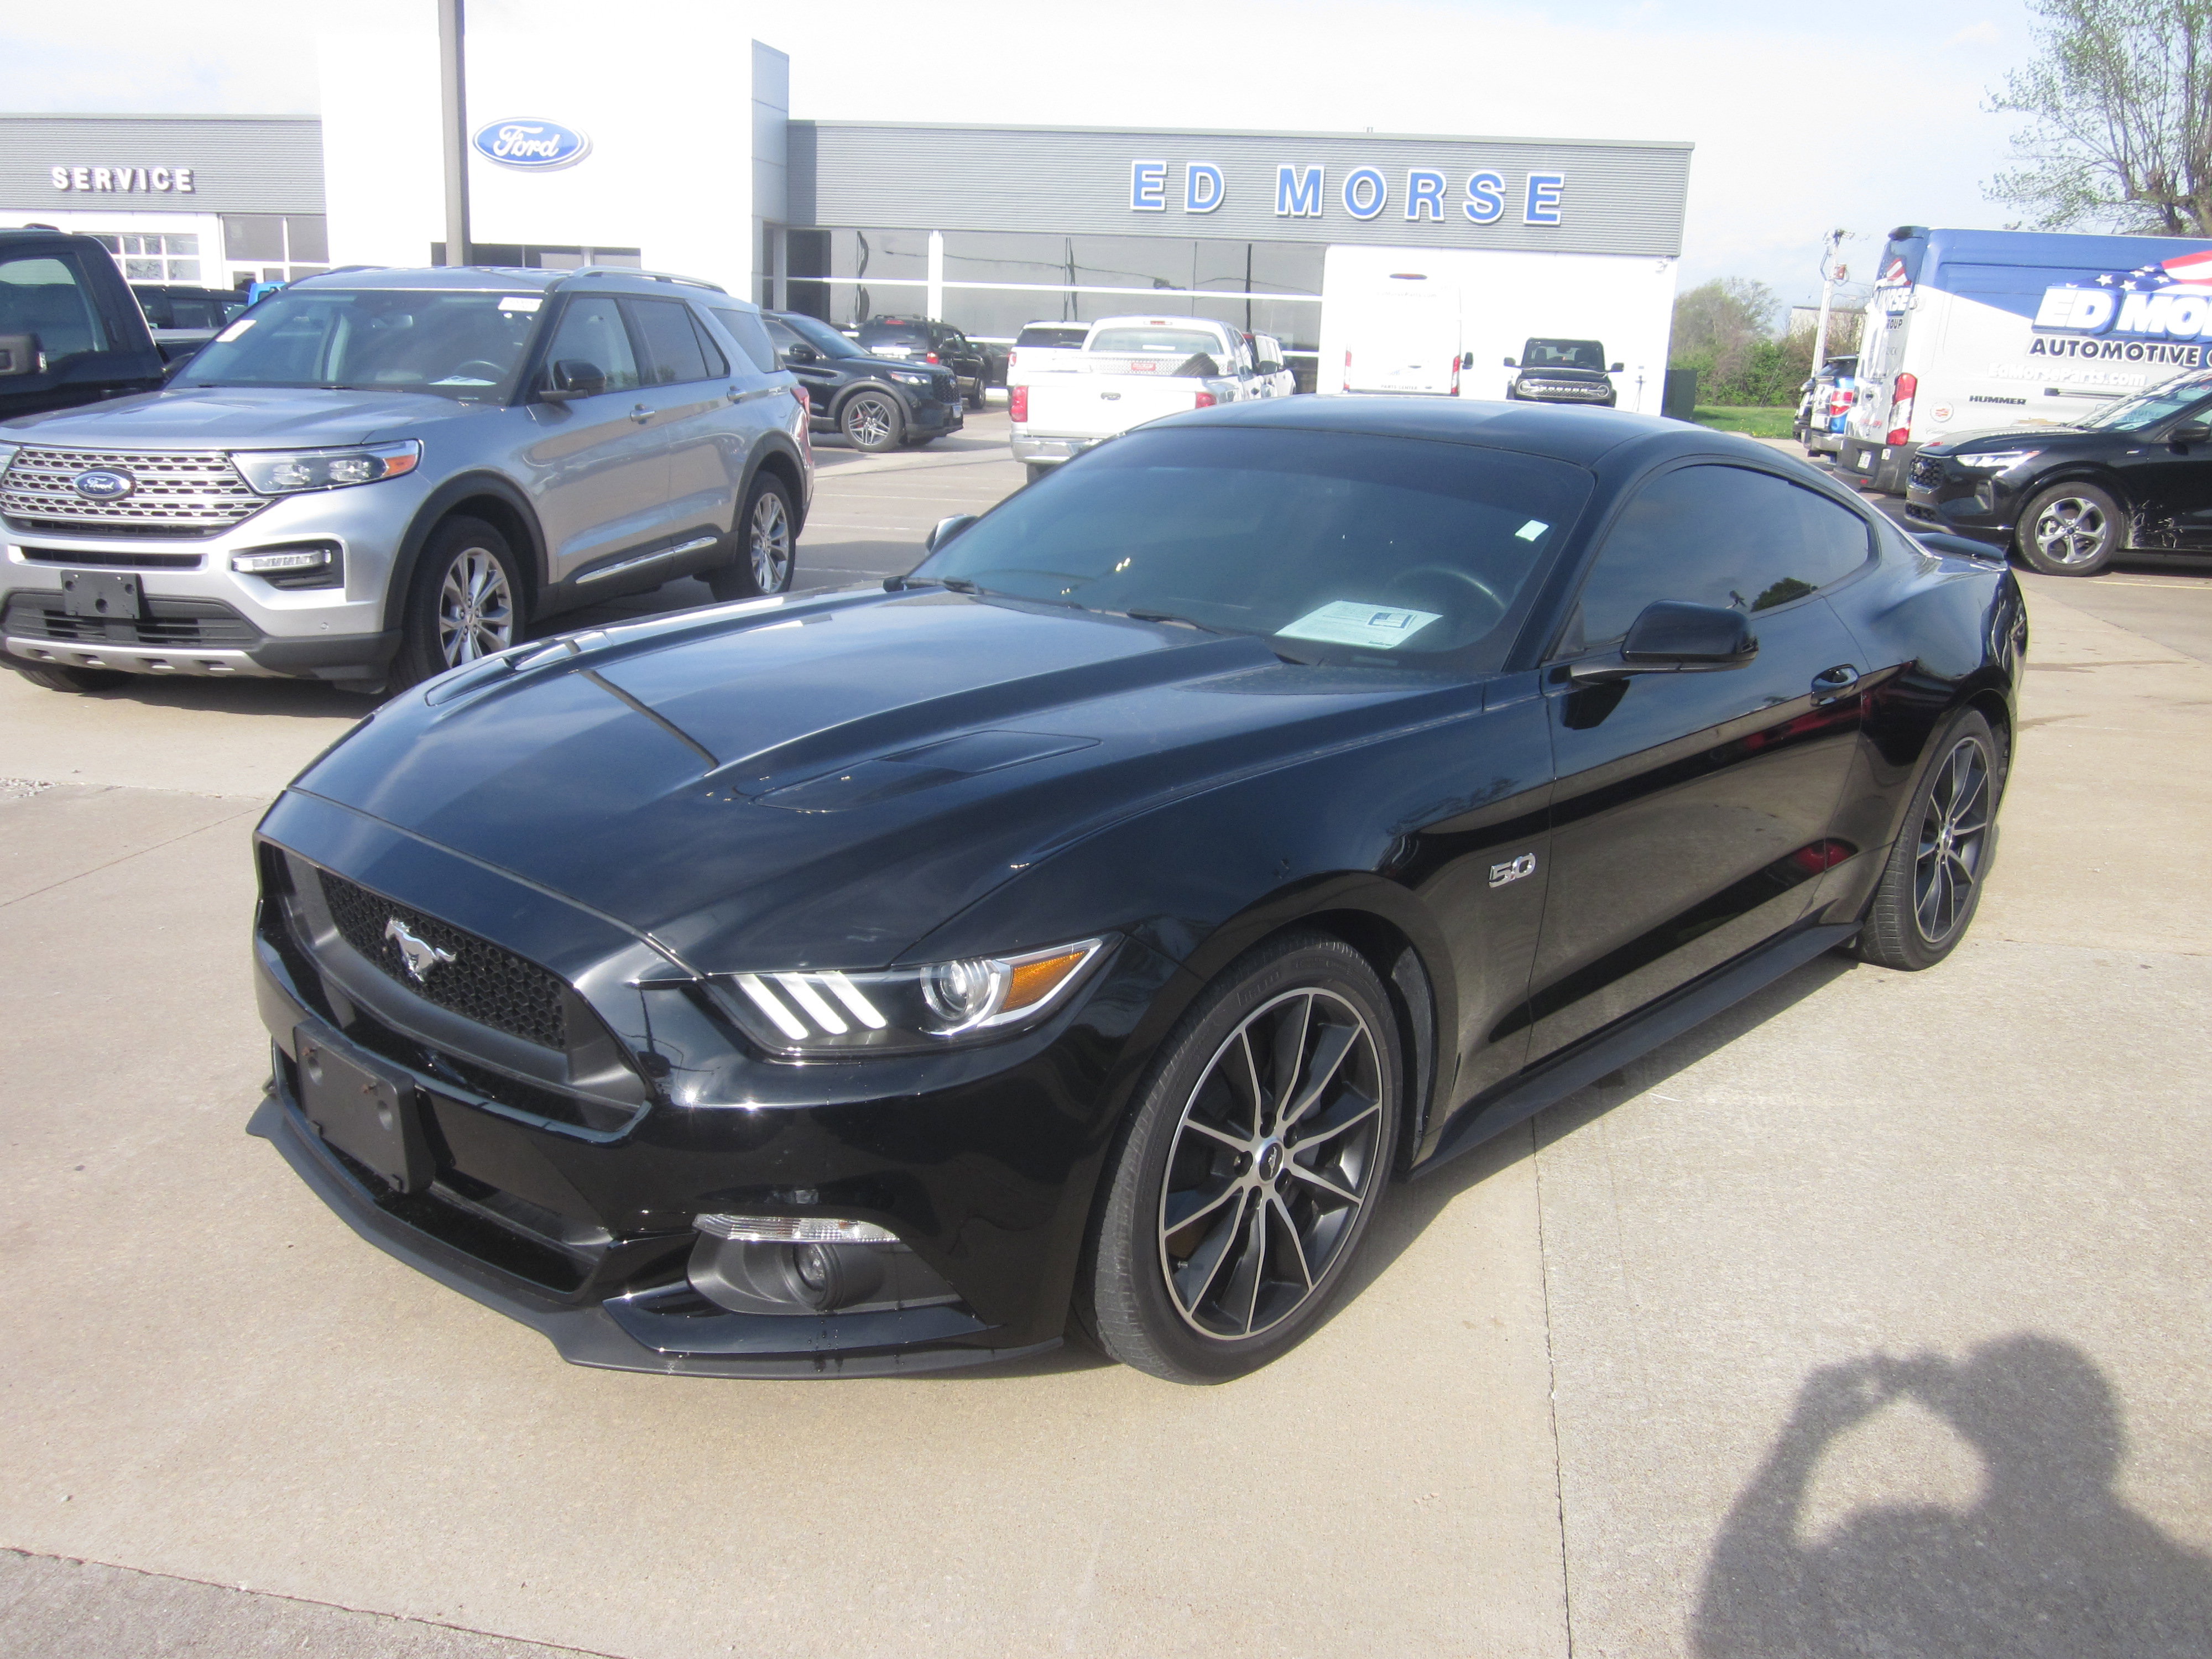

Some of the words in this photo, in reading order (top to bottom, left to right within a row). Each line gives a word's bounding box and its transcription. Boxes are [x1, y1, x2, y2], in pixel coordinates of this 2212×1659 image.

[493, 125, 561, 157] Ford
[51, 166, 194, 192] SERVICE
[1130, 160, 1226, 214] ED
[1274, 164, 1566, 226] MORSE
[2033, 287, 2122, 333] ED
[2115, 291, 2212, 338] MO
[2029, 338, 2200, 366] AUTOMOTIVE
[1988, 362, 2147, 386] EdMorseParts.com
[1969, 395, 2027, 405] HUMMER
[84, 477, 115, 491] Ford
[1489, 853, 1536, 888] 5.0
